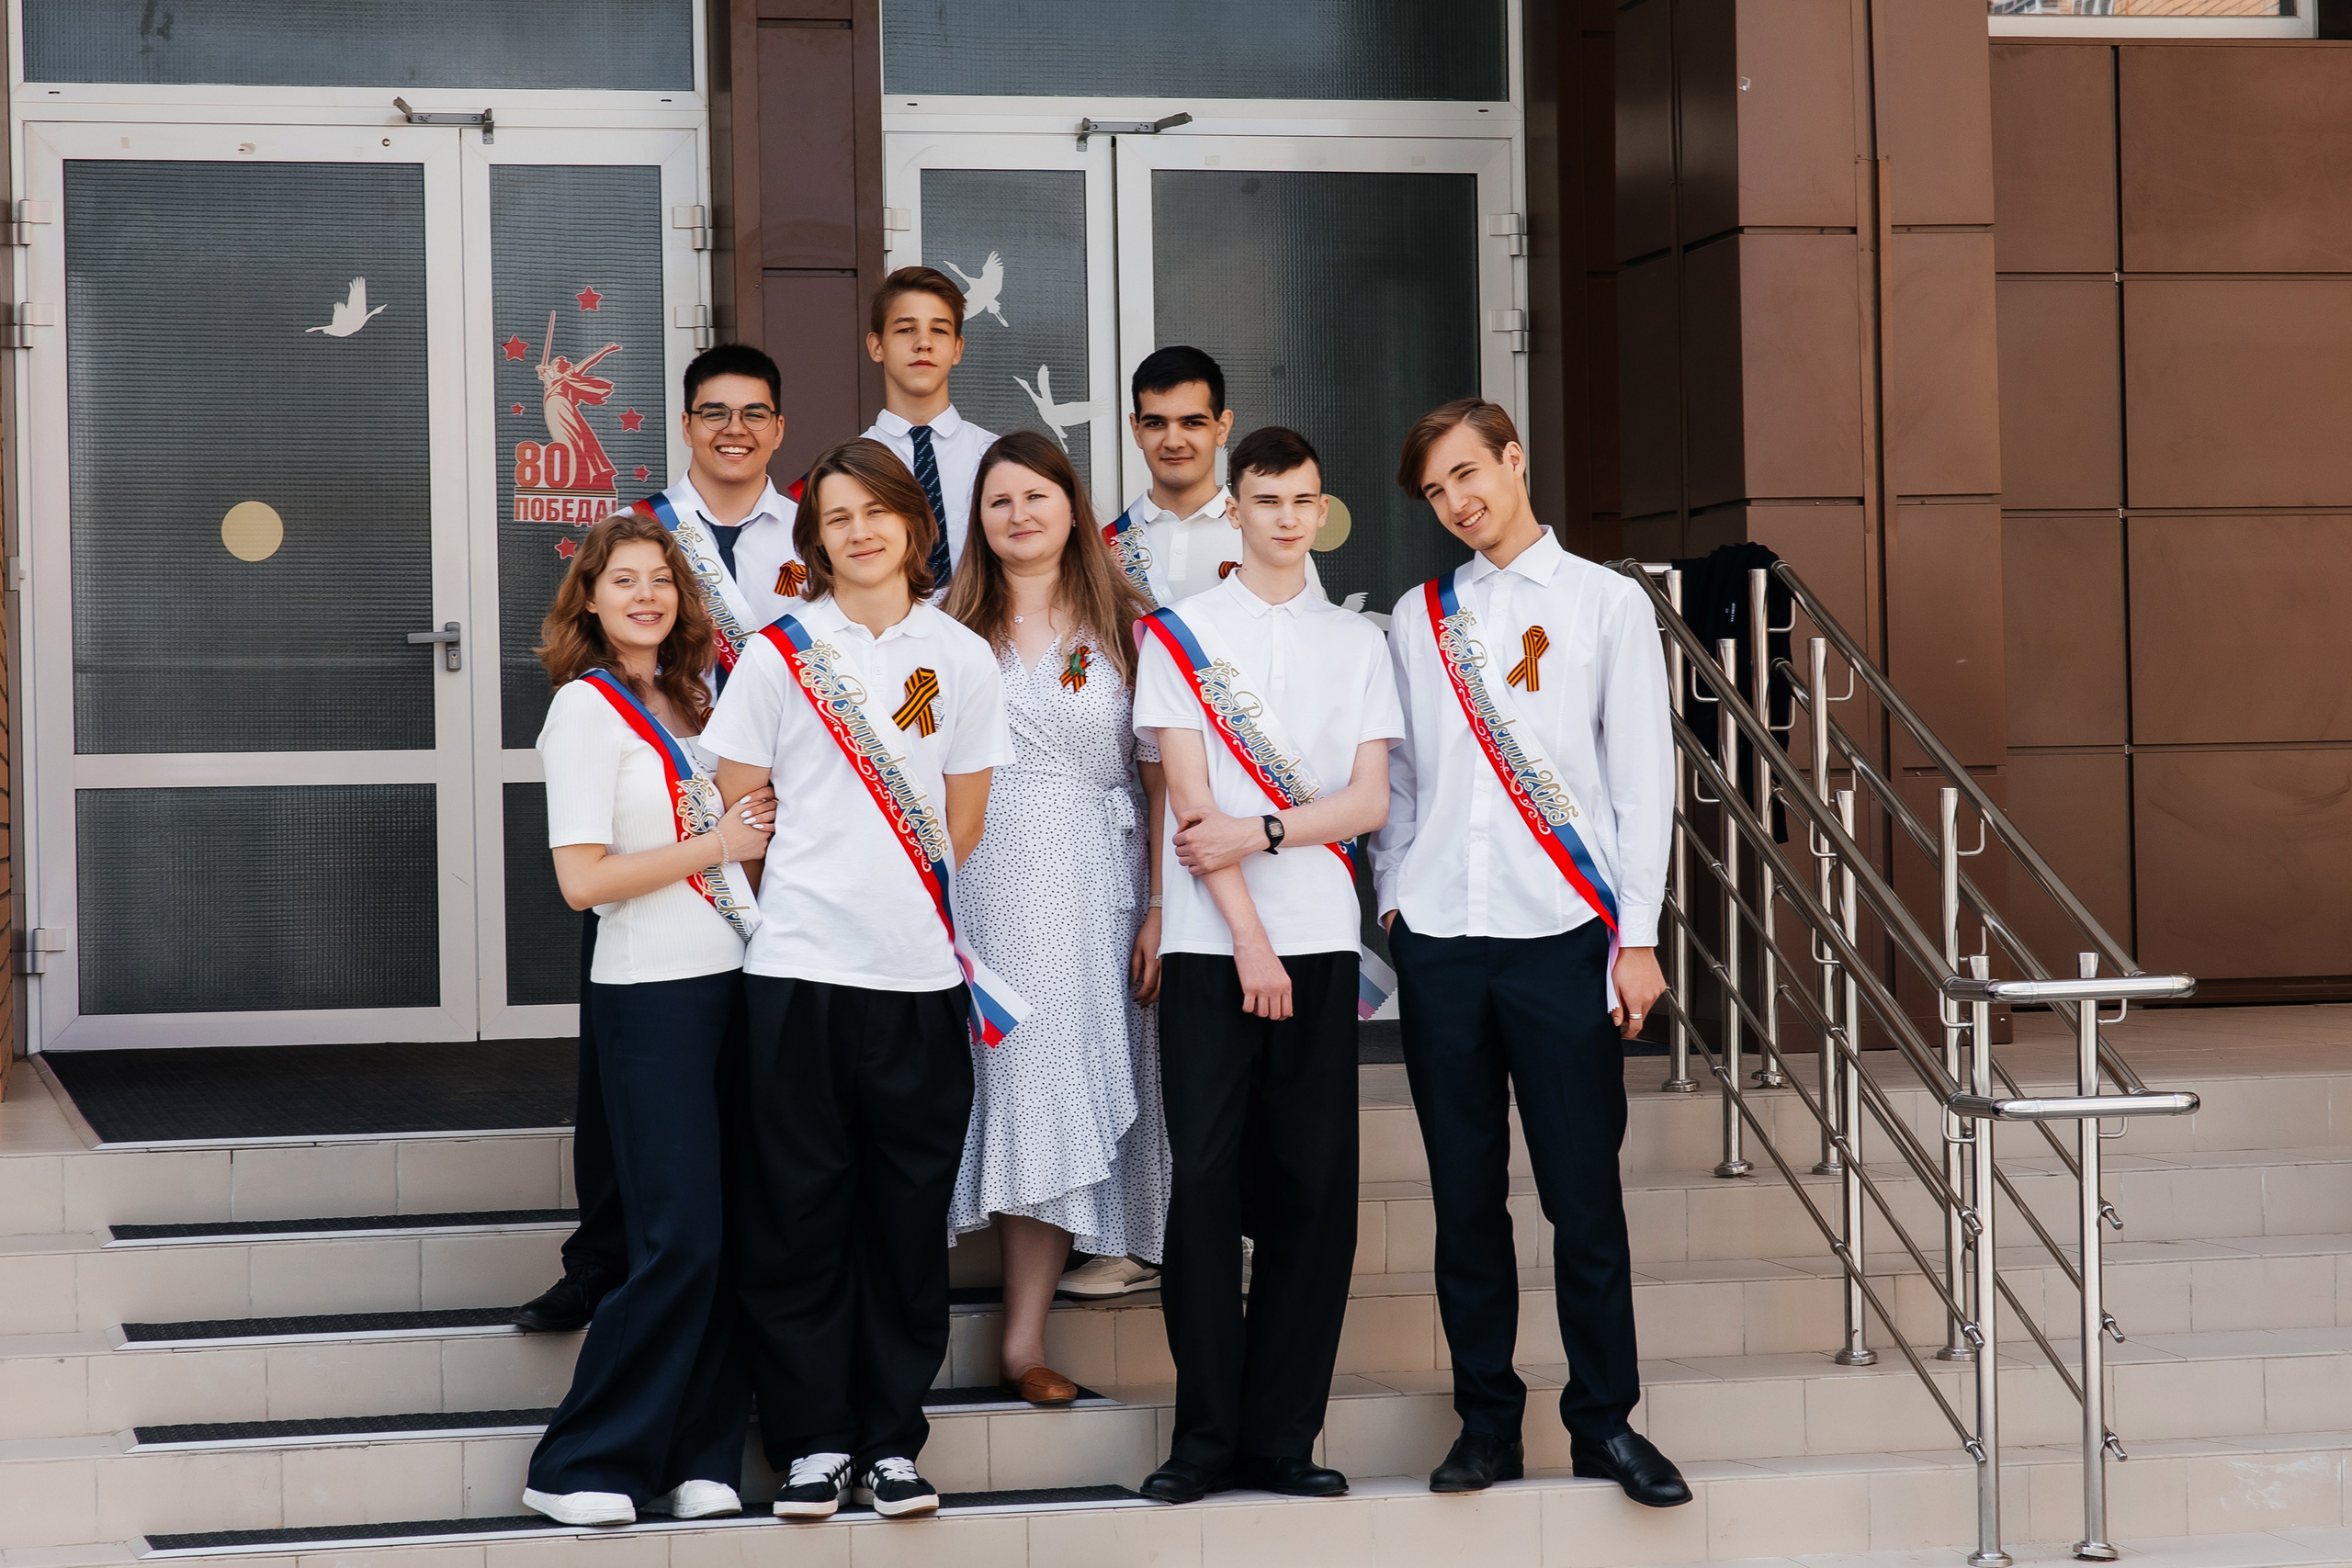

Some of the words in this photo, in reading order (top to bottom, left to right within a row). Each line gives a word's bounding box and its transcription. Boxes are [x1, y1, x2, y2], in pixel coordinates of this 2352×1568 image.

[515, 441, 570, 488] 80
[811, 674, 928, 834] Выпускник
[908, 806, 949, 862] 2025
[1446, 639, 1544, 795] Выпускник
[1521, 769, 1579, 827] 2025
